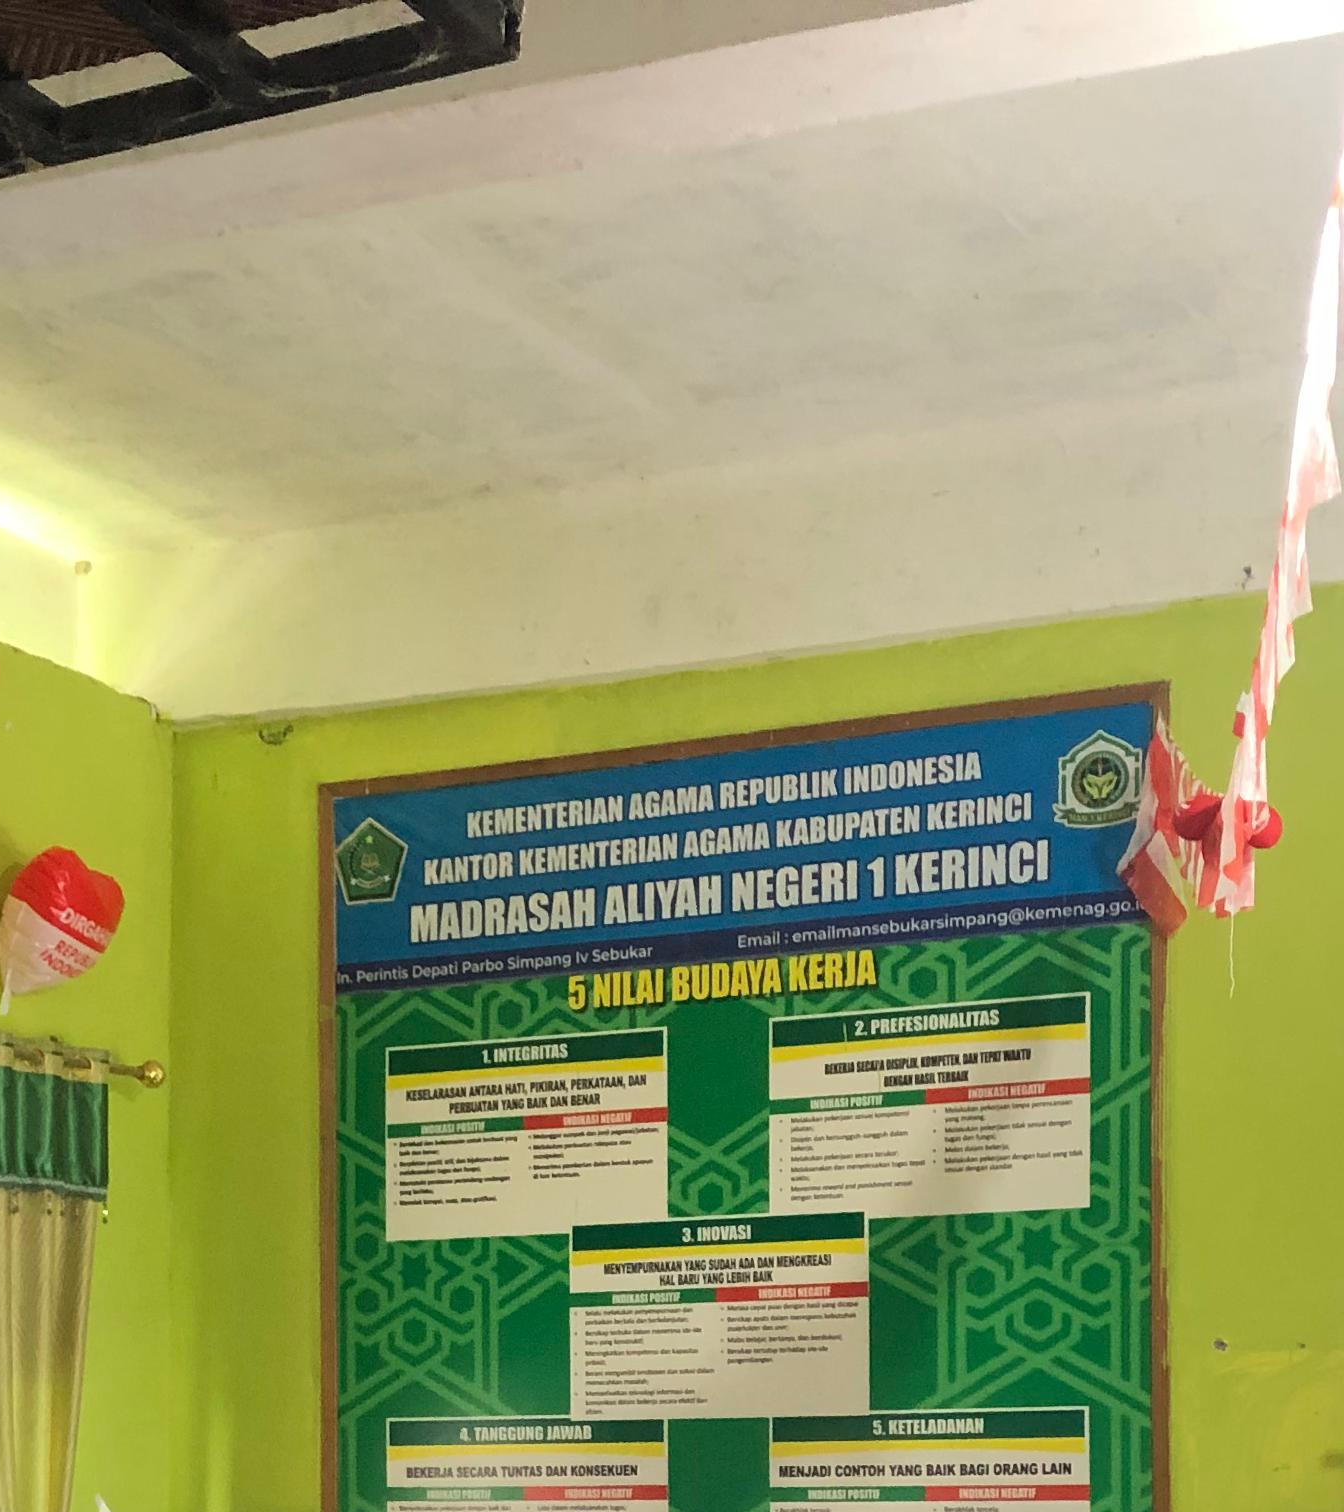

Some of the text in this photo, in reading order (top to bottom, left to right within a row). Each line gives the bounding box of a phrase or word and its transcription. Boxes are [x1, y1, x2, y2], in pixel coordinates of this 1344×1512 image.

[466, 751, 983, 839] KEMENTERIAN AGAMA REPUBLIK INDONESIA
[423, 791, 1033, 886] KANTOR KEMENTERIAN AGAMA KABUPATEN KERINCI
[409, 838, 1050, 943] MADRASAH ALIYAH NEGERI 1 KERINCI
[737, 931, 781, 949] Email
[356, 967, 409, 984] Perintis
[412, 961, 459, 980] Depati
[461, 957, 504, 975] Parbo
[507, 953, 572, 972] Simpang
[592, 944, 654, 963] Sebukar
[567, 949, 877, 1010] 5 NILAI BUDAYA KERJA
[854, 1009, 1000, 1036] 2. PREFESIONALITAS
[481, 1043, 568, 1064] 1. INTEGRITAS
[406, 1084, 467, 1101] KESELARASAN
[468, 1081, 503, 1097] ANTARA
[628, 1073, 647, 1087] DAN
[448, 1093, 601, 1115] PERBUATAN YANG BAIK DAN BENAR
[681, 1224, 752, 1243] 3. INOVASI
[603, 1259, 683, 1276] MENYEMPURNAKAN
[684, 1258, 707, 1272] YANG
[708, 1257, 737, 1270] SUDAH
[738, 1256, 755, 1269] ADA
[757, 1256, 775, 1268] DAN
[659, 1270, 773, 1287] HAL BARU YANG LEBIH BAIK
[459, 1424, 592, 1442] 4. TANGGUNG JAWAB
[872, 1417, 984, 1436] 5. KETELADANAN
[406, 1463, 638, 1480] BEKERJA SECARA TUNTAS DAN KONSEKUEN
[778, 1462, 1073, 1479] MENJADI CONTOH YANG BAIK BAGI ORANG LAIN
